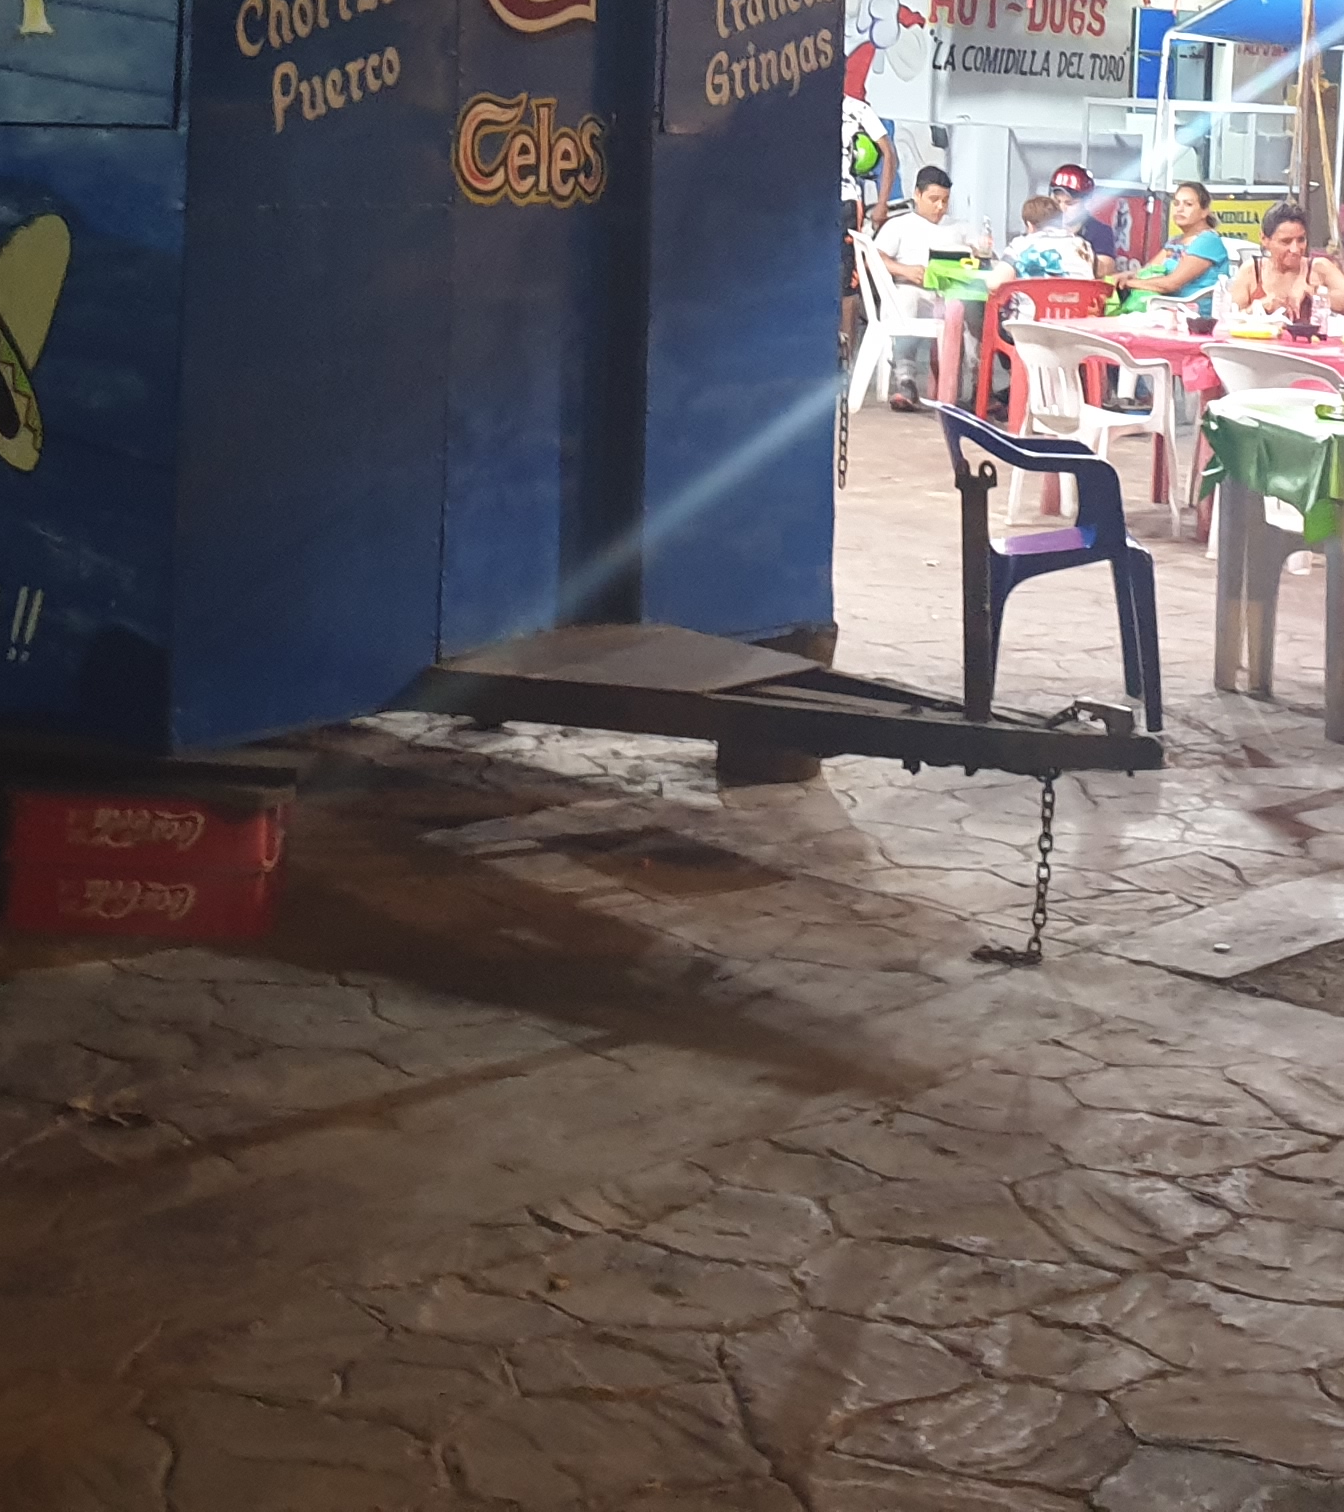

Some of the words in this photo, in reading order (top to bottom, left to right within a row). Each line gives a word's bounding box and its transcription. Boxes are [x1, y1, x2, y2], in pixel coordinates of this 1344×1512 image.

[272, 45, 401, 134] Puerco
[704, 27, 834, 108] Gringas
[962, 44, 1051, 78] COMIDILLA
[1057, 51, 1085, 80] DEL
[452, 91, 608, 208] Celes
